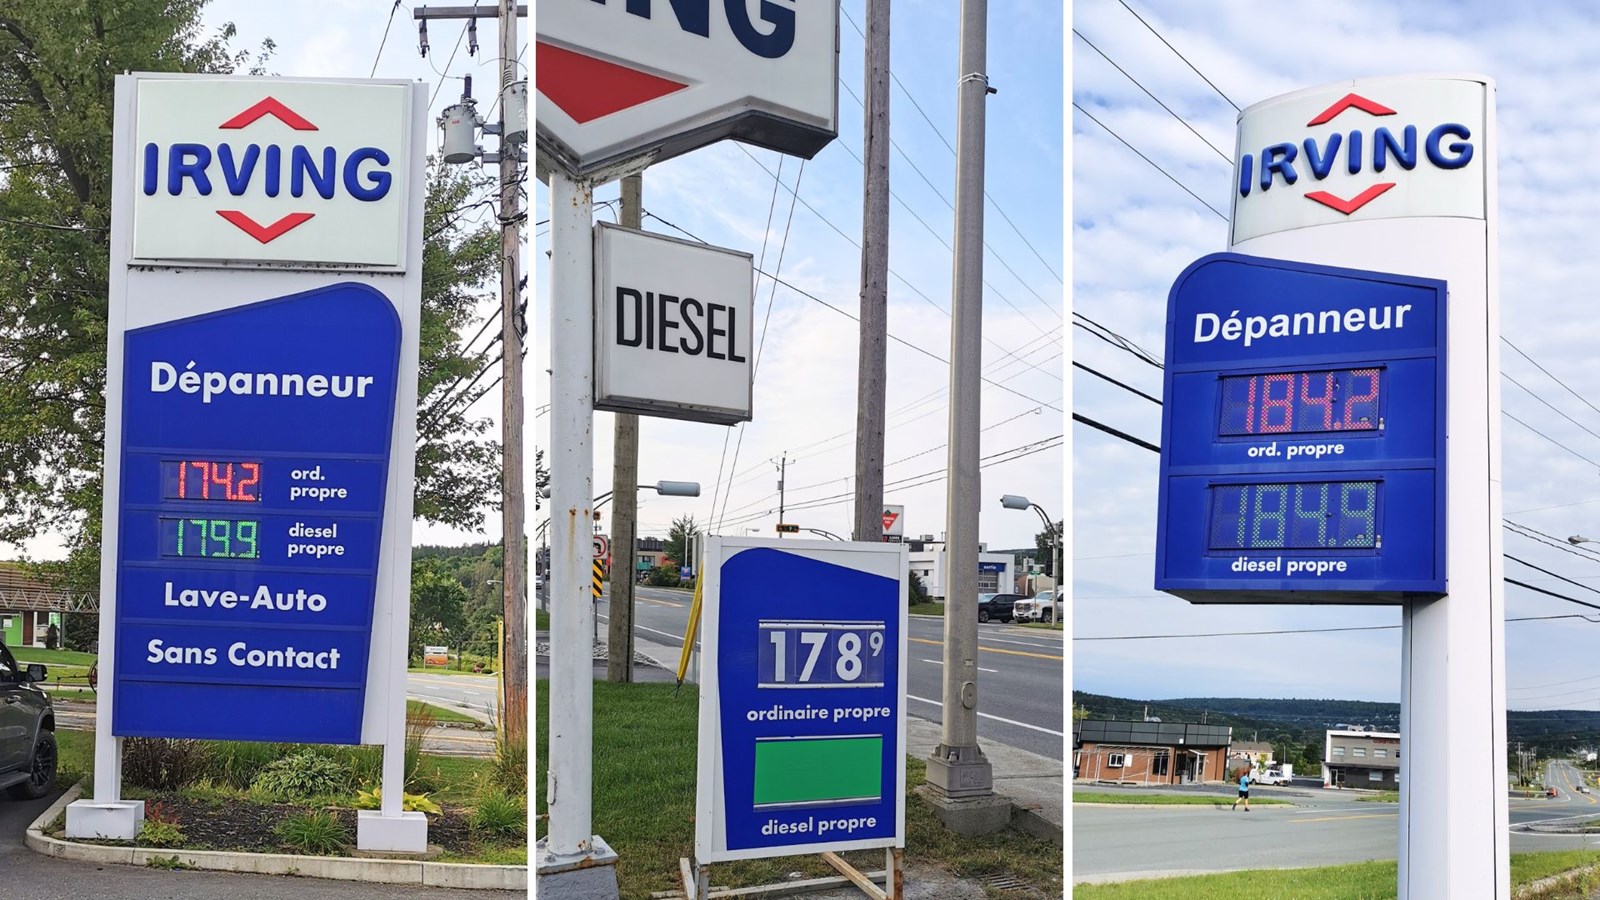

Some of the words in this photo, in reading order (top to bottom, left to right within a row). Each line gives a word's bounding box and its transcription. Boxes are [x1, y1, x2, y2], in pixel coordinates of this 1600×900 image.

[1240, 123, 1474, 198] IRVING
[143, 142, 392, 202] IRVING
[616, 286, 746, 363] DIESEL
[1193, 303, 1413, 347] Dépanneur
[150, 360, 374, 404] Dépanneur
[1247, 442, 1282, 457] ord.
[1286, 443, 1345, 460] propre
[290, 465, 326, 481] ord.
[290, 485, 348, 501] propre
[288, 522, 338, 539] diesel
[287, 542, 345, 559] propre
[1231, 556, 1282, 573] diesel
[1286, 559, 1348, 576] propre
[164, 581, 328, 613] Lave-Auto
[146, 638, 218, 666] Sans
[227, 641, 341, 670] Contact
[746, 704, 830, 722] ordinaire
[833, 705, 892, 723] propre
[760, 816, 814, 836] diesel
[817, 816, 878, 836] propre
